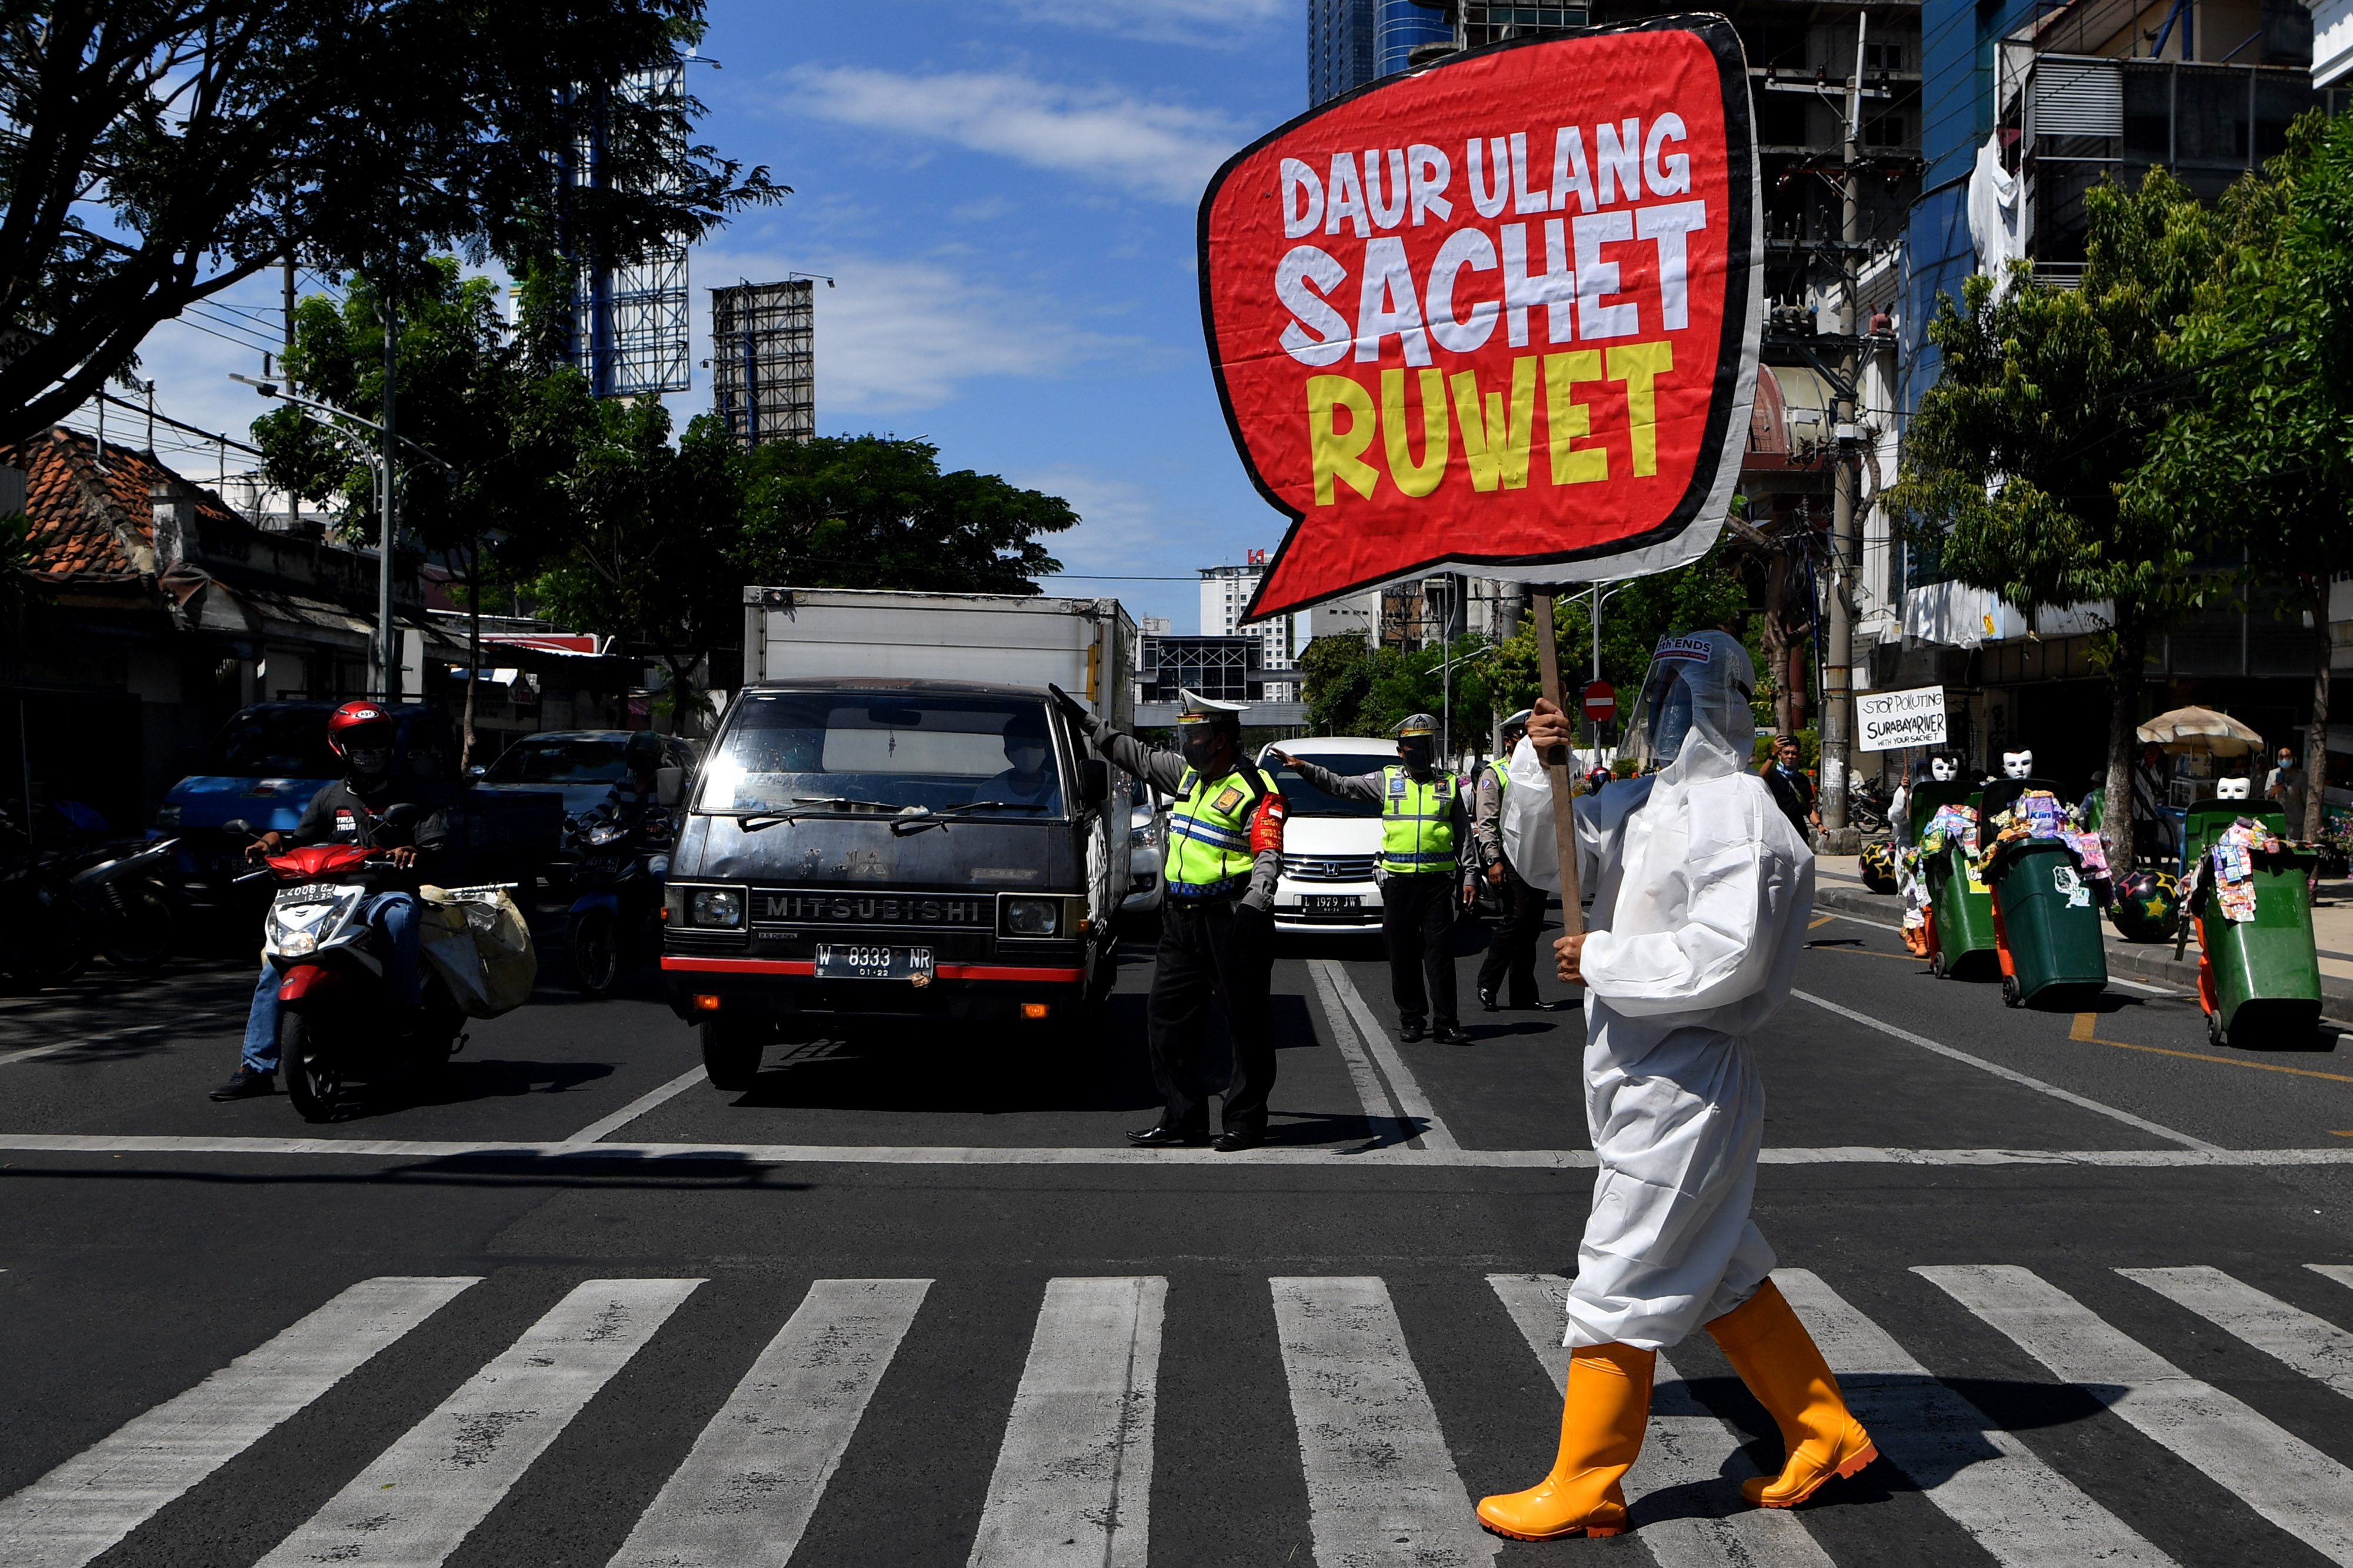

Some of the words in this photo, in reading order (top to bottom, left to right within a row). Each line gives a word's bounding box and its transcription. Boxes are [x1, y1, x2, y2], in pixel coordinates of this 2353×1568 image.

[1280, 144, 1452, 238] DAUR
[1467, 112, 1691, 219] ULANG
[1275, 200, 1706, 367] SACHET
[1307, 341, 1673, 506] RUWET
[1675, 639, 1710, 652] ENDS
[1862, 697, 1893, 714] STOP
[1878, 738, 1892, 746] WITH
[1910, 733, 1938, 743] SACHET
[2031, 810, 2051, 819] Klin
[767, 897, 978, 921] MITSUBISHI
[1305, 896, 1309, 906] L
[1317, 897, 1338, 907] 1979
[1344, 897, 1357, 907] JW
[819, 946, 831, 965] W
[849, 947, 891, 966] 8333
[909, 949, 930, 968] NR
